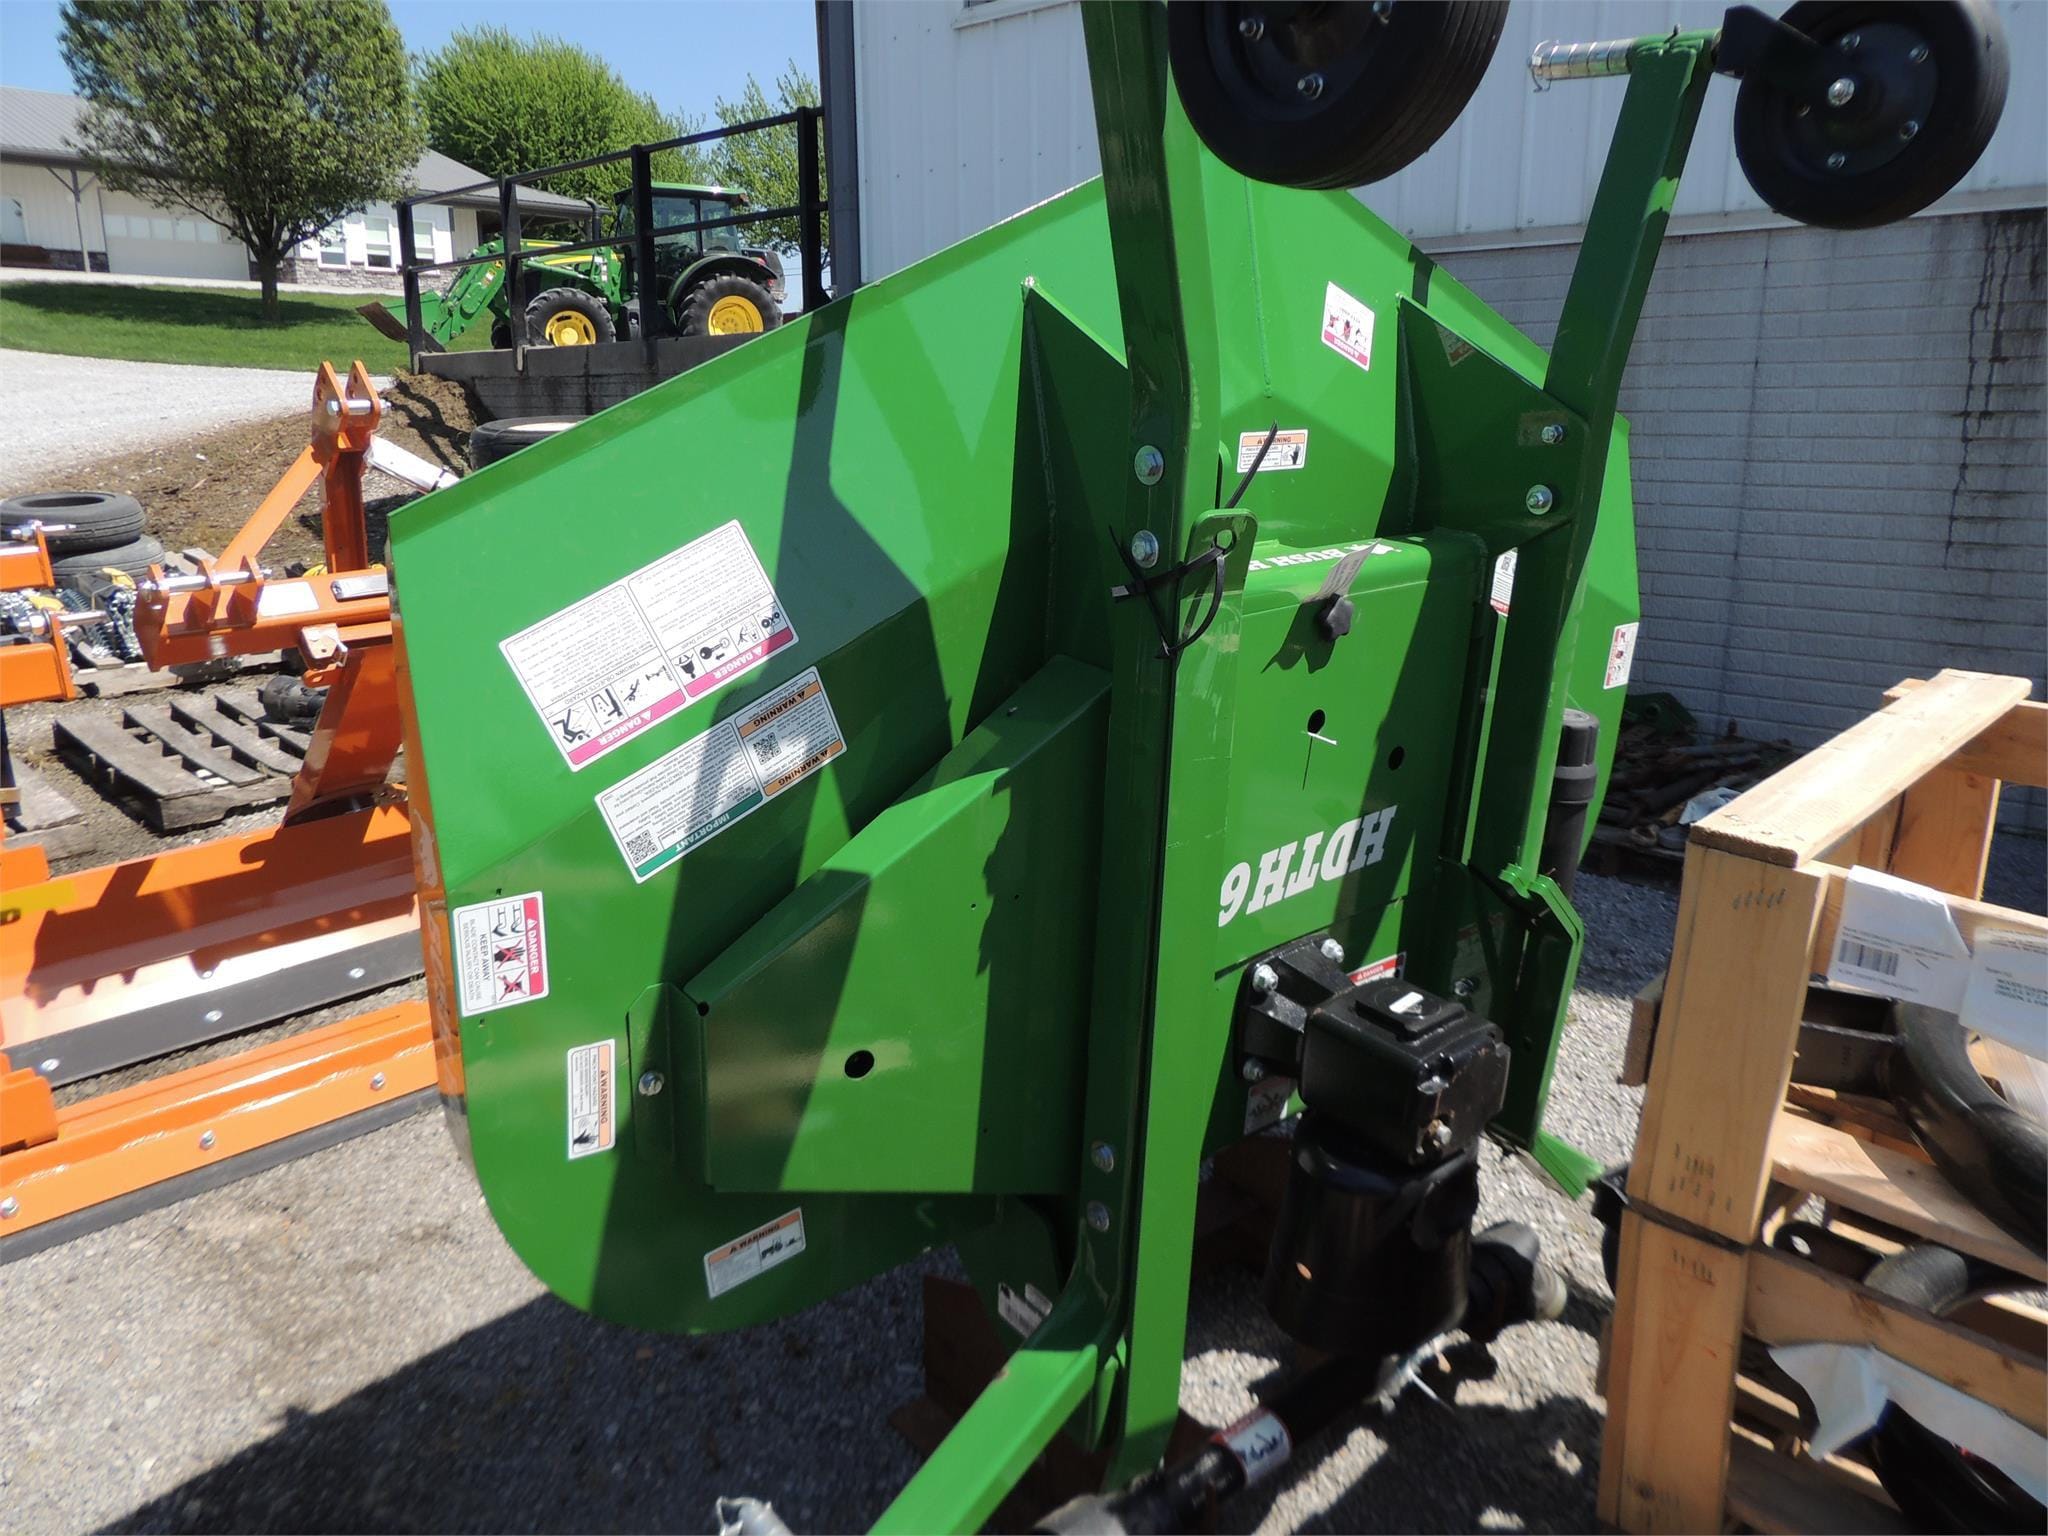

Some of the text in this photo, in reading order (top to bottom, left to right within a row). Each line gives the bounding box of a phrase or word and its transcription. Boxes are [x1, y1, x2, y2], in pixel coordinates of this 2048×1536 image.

[1266, 548, 1346, 566] BUSH
[712, 651, 754, 679] DANGER
[753, 696, 796, 727] WARNING
[597, 715, 642, 745] DANGER
[777, 755, 820, 786] WARNING
[673, 812, 730, 851] IMPORTANT
[1218, 805, 1397, 927] HDTH6
[528, 930, 538, 973] DANGER
[739, 1224, 780, 1248] WARNING
